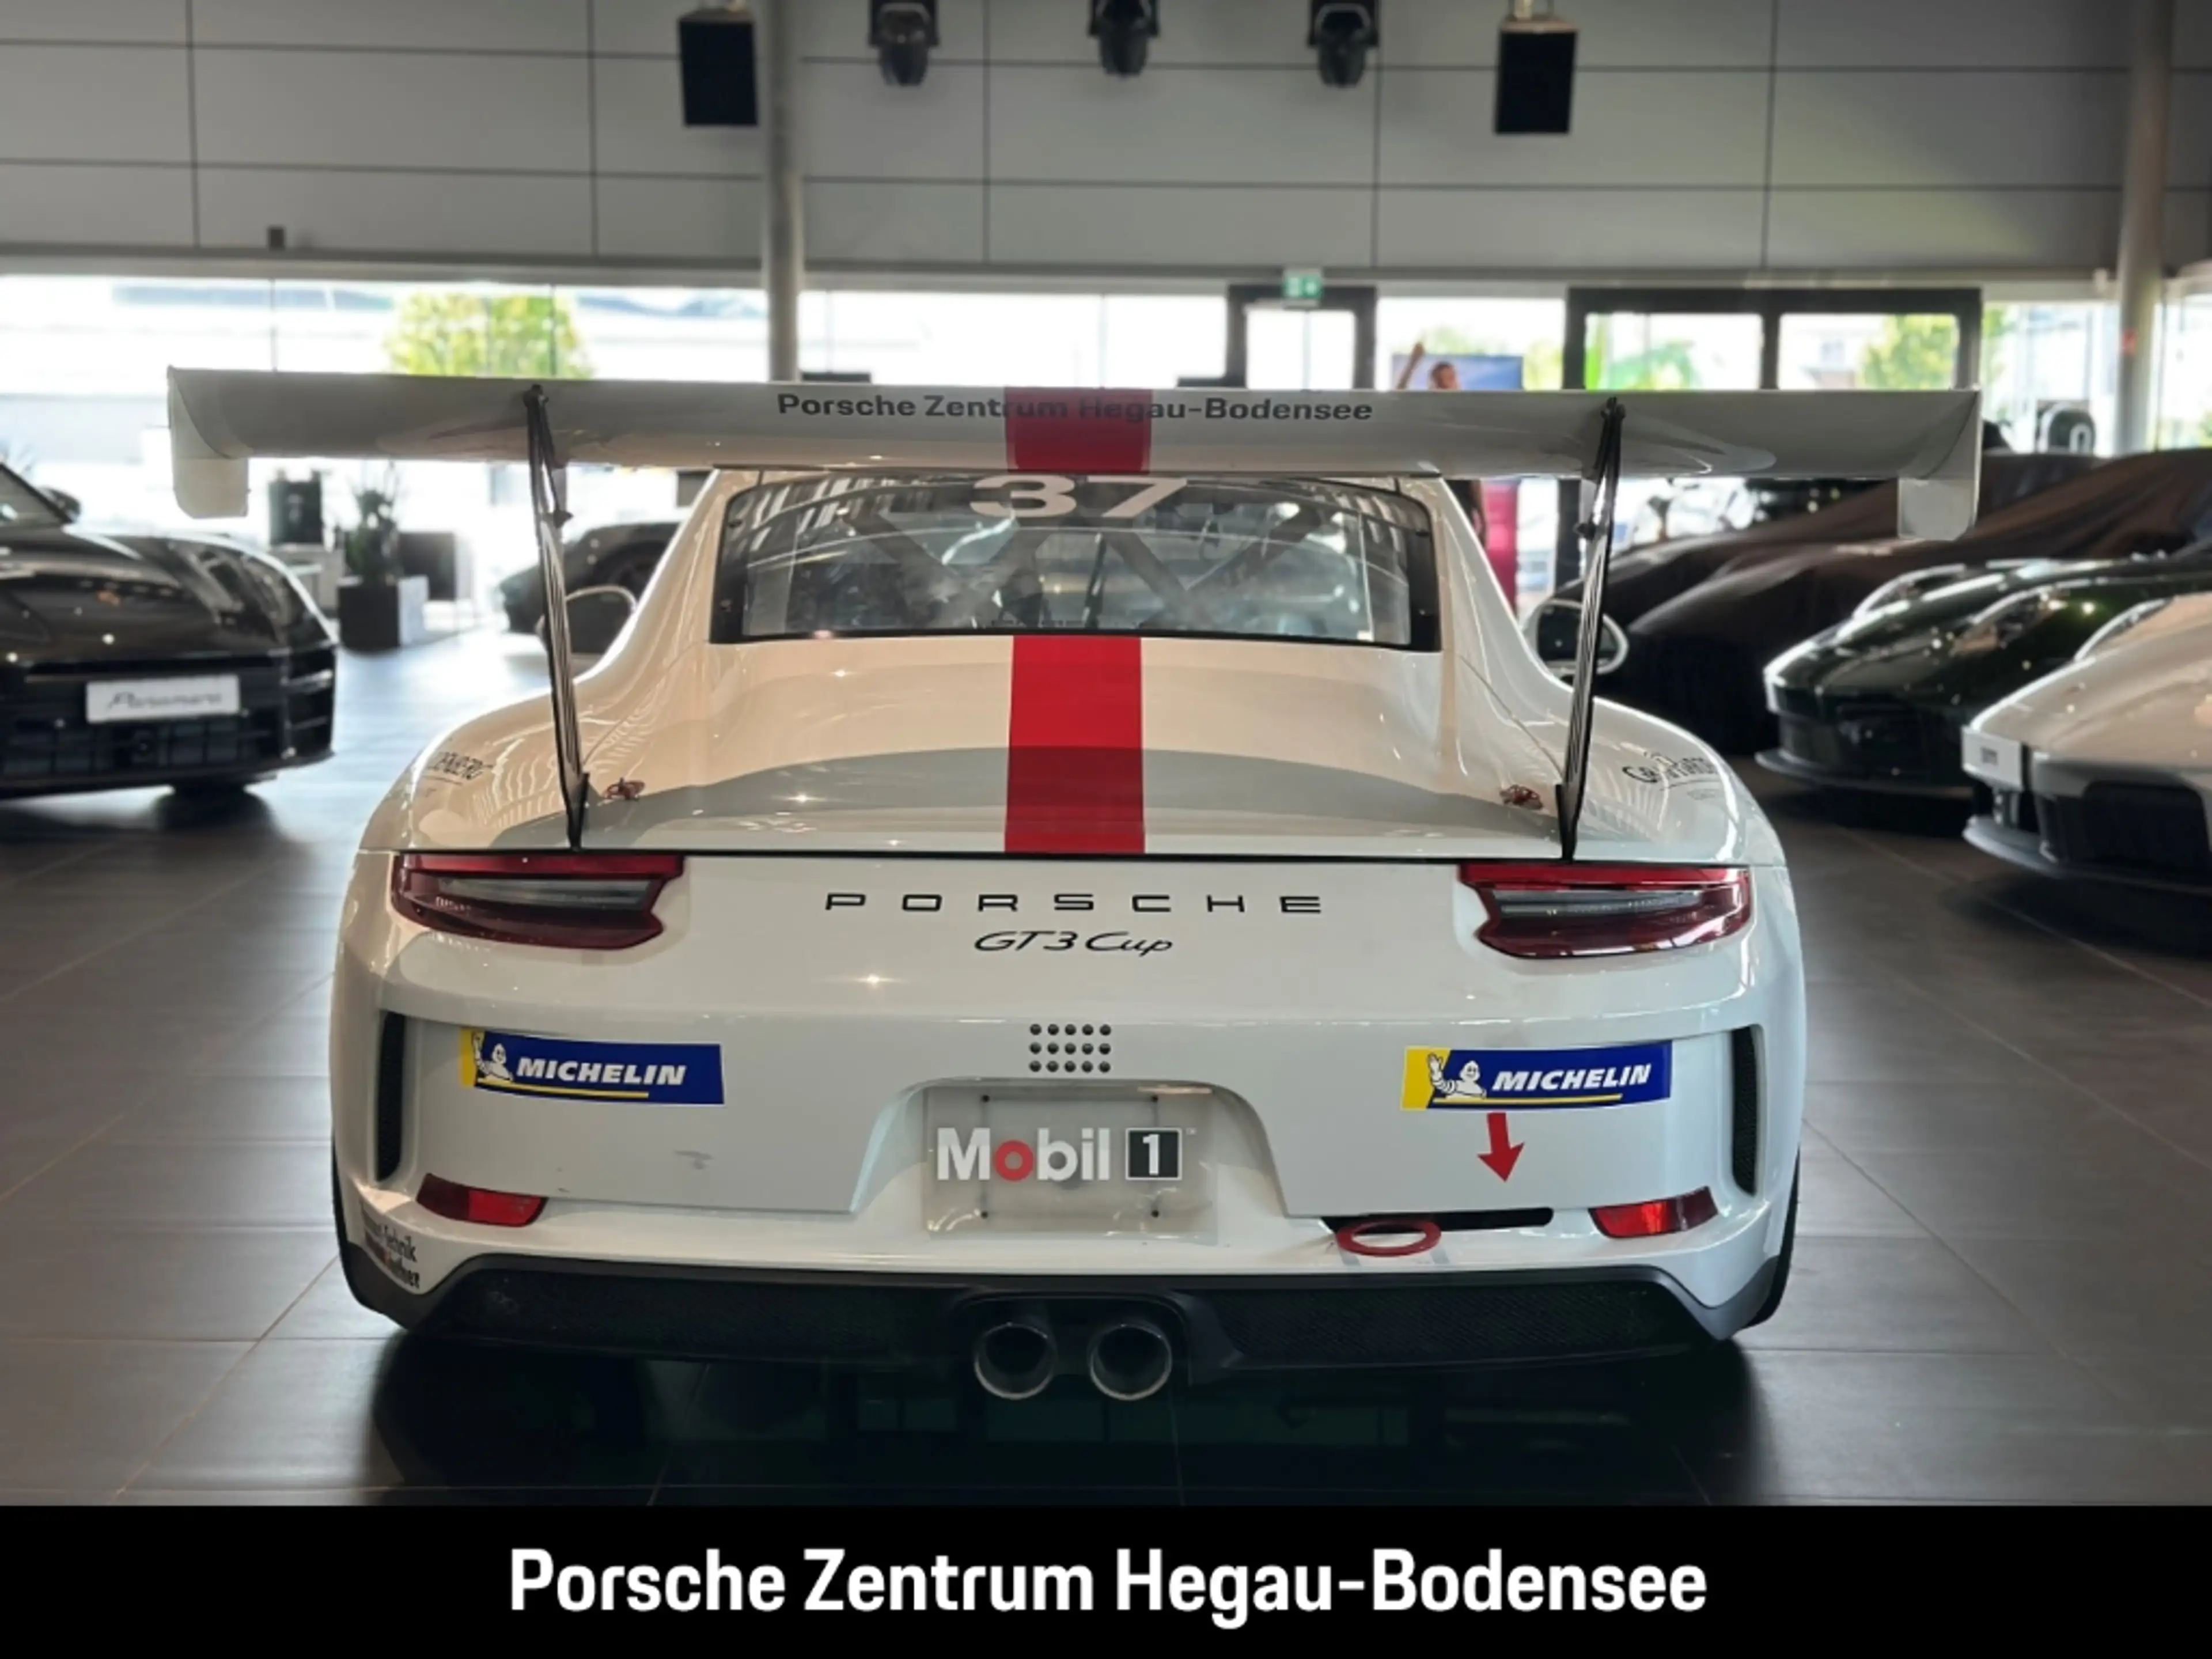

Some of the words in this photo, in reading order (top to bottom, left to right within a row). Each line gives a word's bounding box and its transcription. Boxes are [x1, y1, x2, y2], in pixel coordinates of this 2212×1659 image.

[778, 393, 916, 416] Porsche
[923, 395, 1067, 416] Zentrum
[1078, 396, 1373, 420] Hegau-Bodensee
[970, 475, 1187, 518] 37
[825, 893, 1321, 913] PORSCHE
[974, 930, 1079, 951] GT3
[1085, 931, 1173, 957] Cup
[517, 1057, 687, 1085] MICHELIN
[1491, 1063, 1652, 1092] MICHELIN
[937, 1127, 1111, 1181] Mobil
[1142, 1134, 1160, 1176] 1
